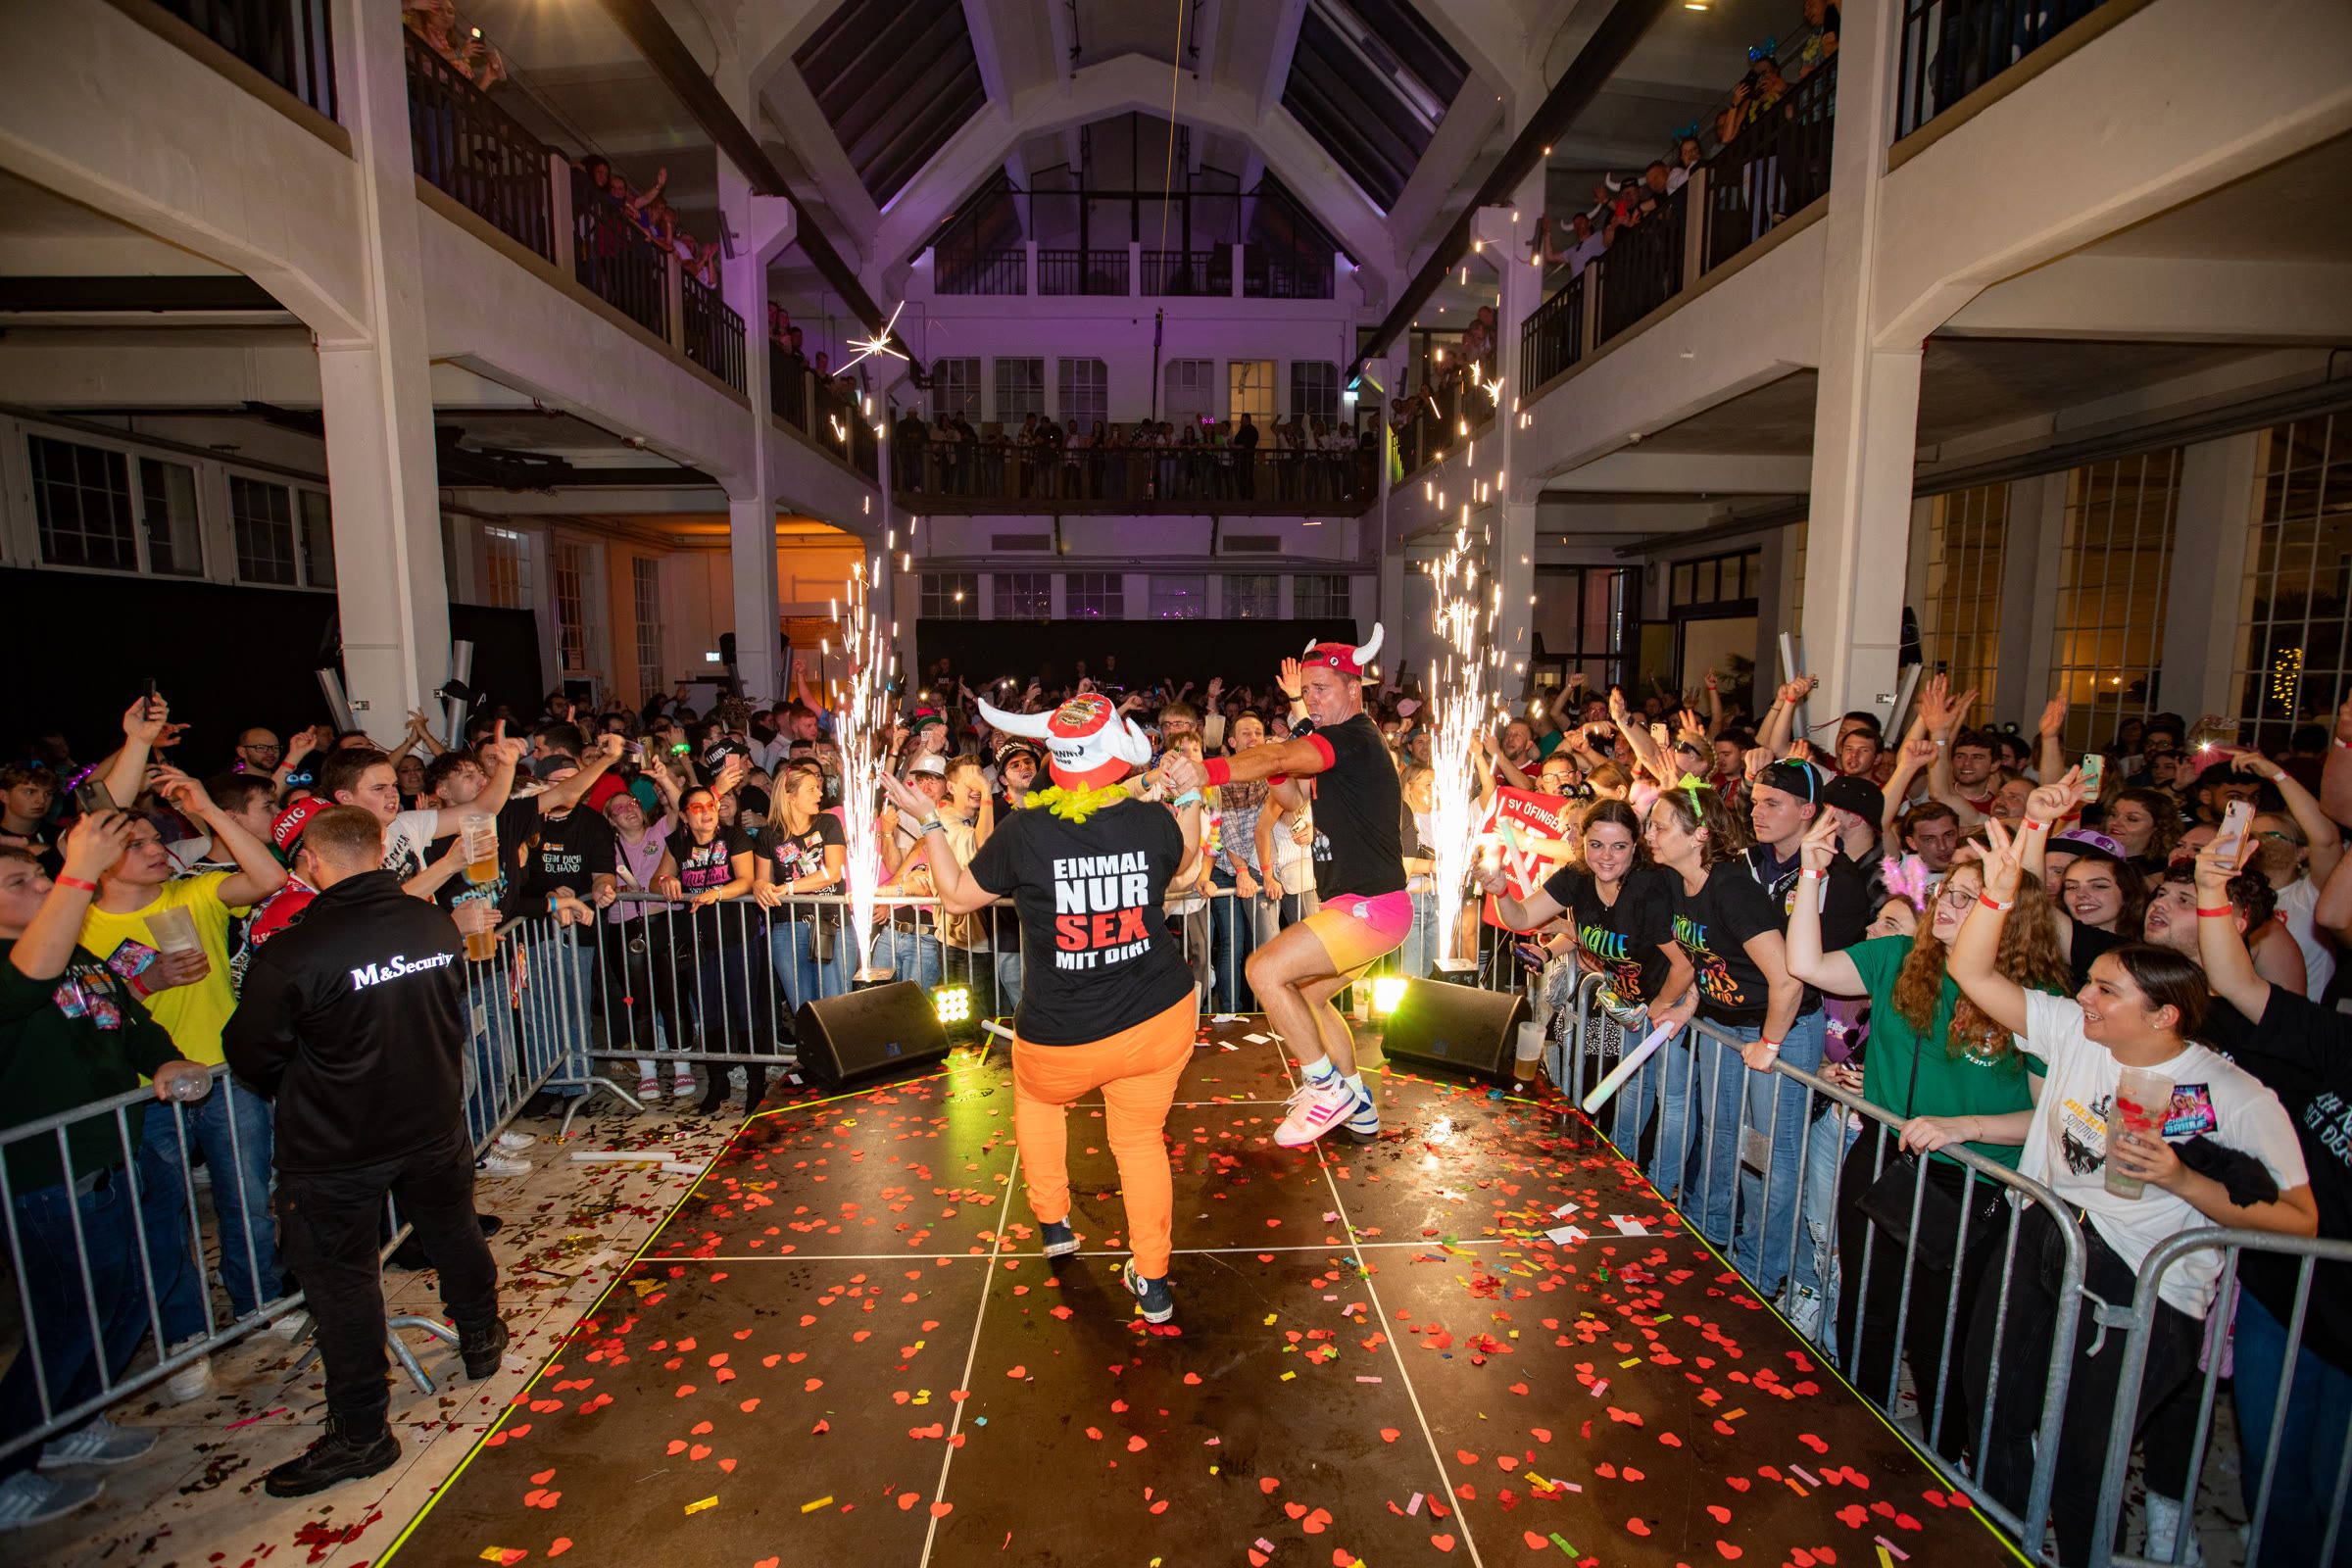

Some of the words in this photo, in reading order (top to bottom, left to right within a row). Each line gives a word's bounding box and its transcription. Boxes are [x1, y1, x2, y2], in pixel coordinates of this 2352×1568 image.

[1508, 799, 1523, 810] SV
[557, 863, 580, 873] HAND
[1054, 851, 1150, 879] EINMAL
[1054, 873, 1150, 914] NUR
[1055, 906, 1151, 952] SEX
[350, 952, 454, 991] M&Security
[1055, 951, 1099, 970] MIT
[2063, 1098, 2107, 1136] BIERK
